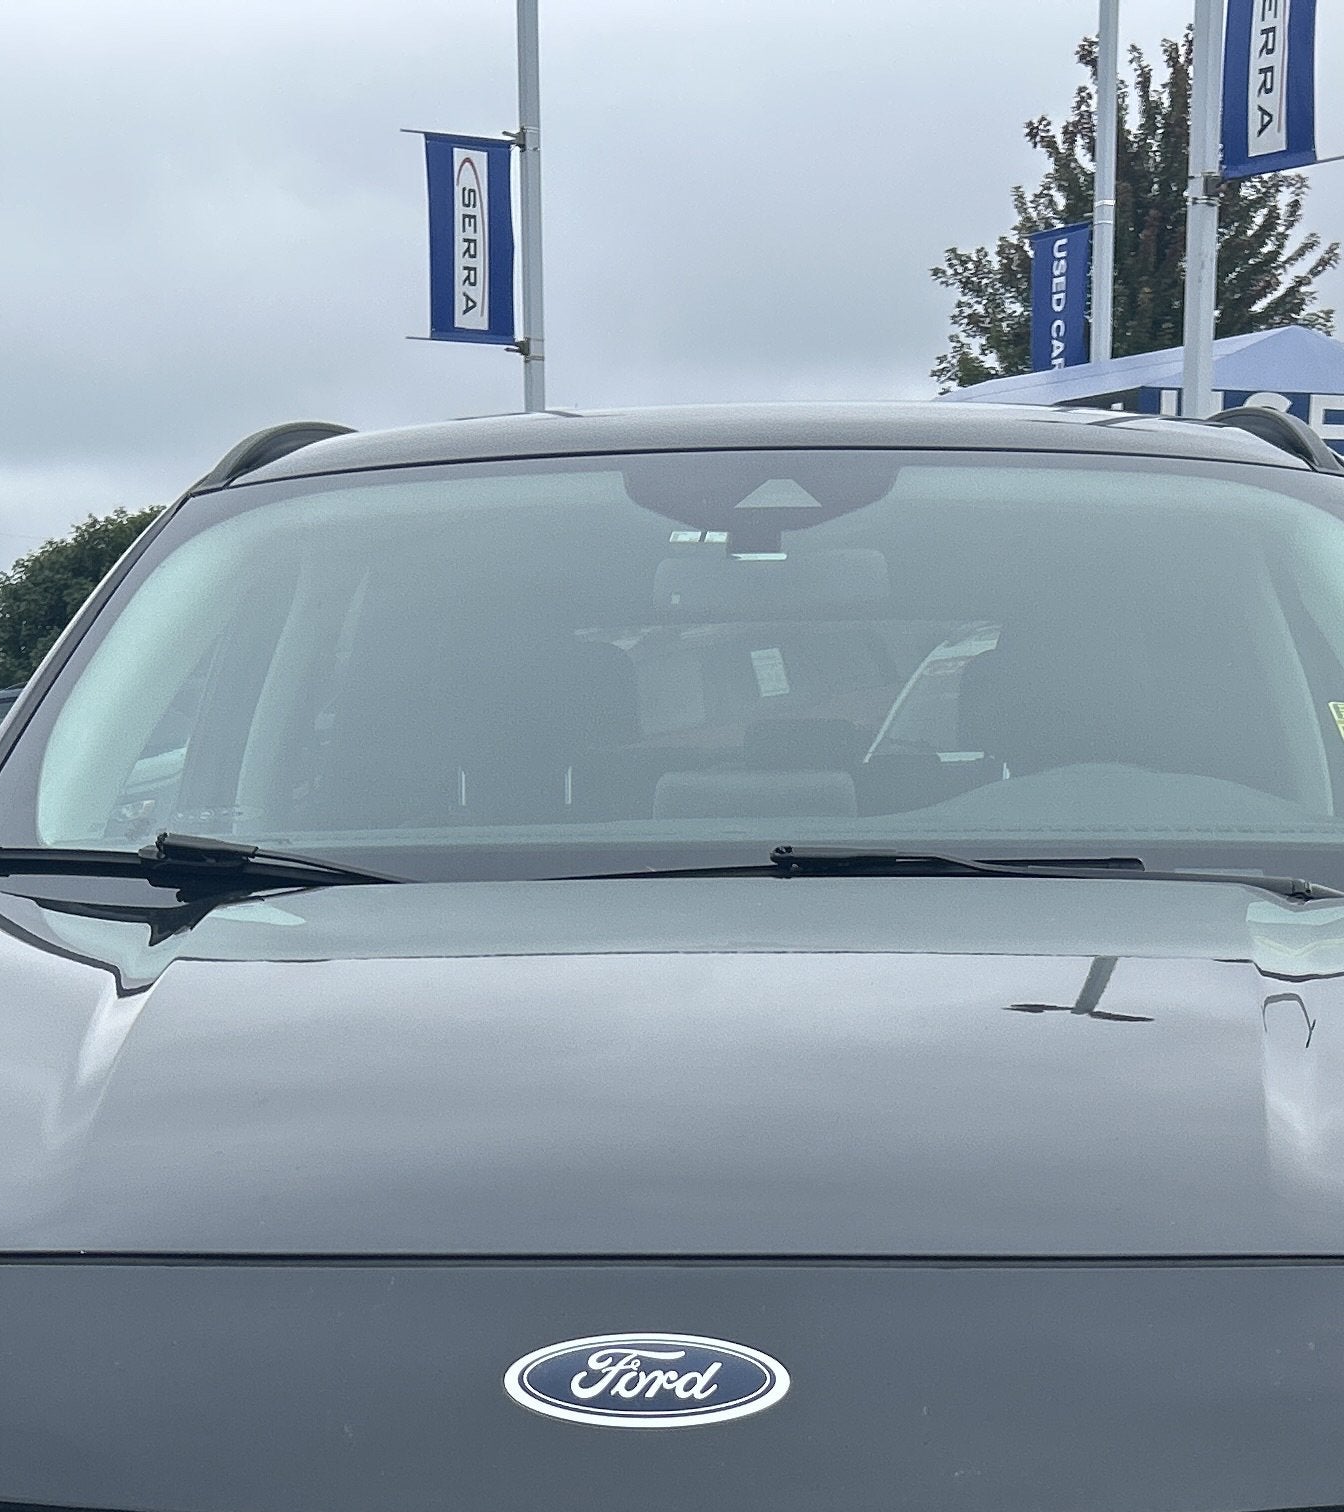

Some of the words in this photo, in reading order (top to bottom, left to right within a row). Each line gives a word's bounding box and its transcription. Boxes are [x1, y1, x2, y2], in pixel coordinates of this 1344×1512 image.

[1257, 0, 1278, 138] ERRA
[461, 186, 478, 316] SERRA
[1051, 237, 1069, 313] USED
[1050, 318, 1066, 370] CAR
[569, 1347, 723, 1401] Ford
